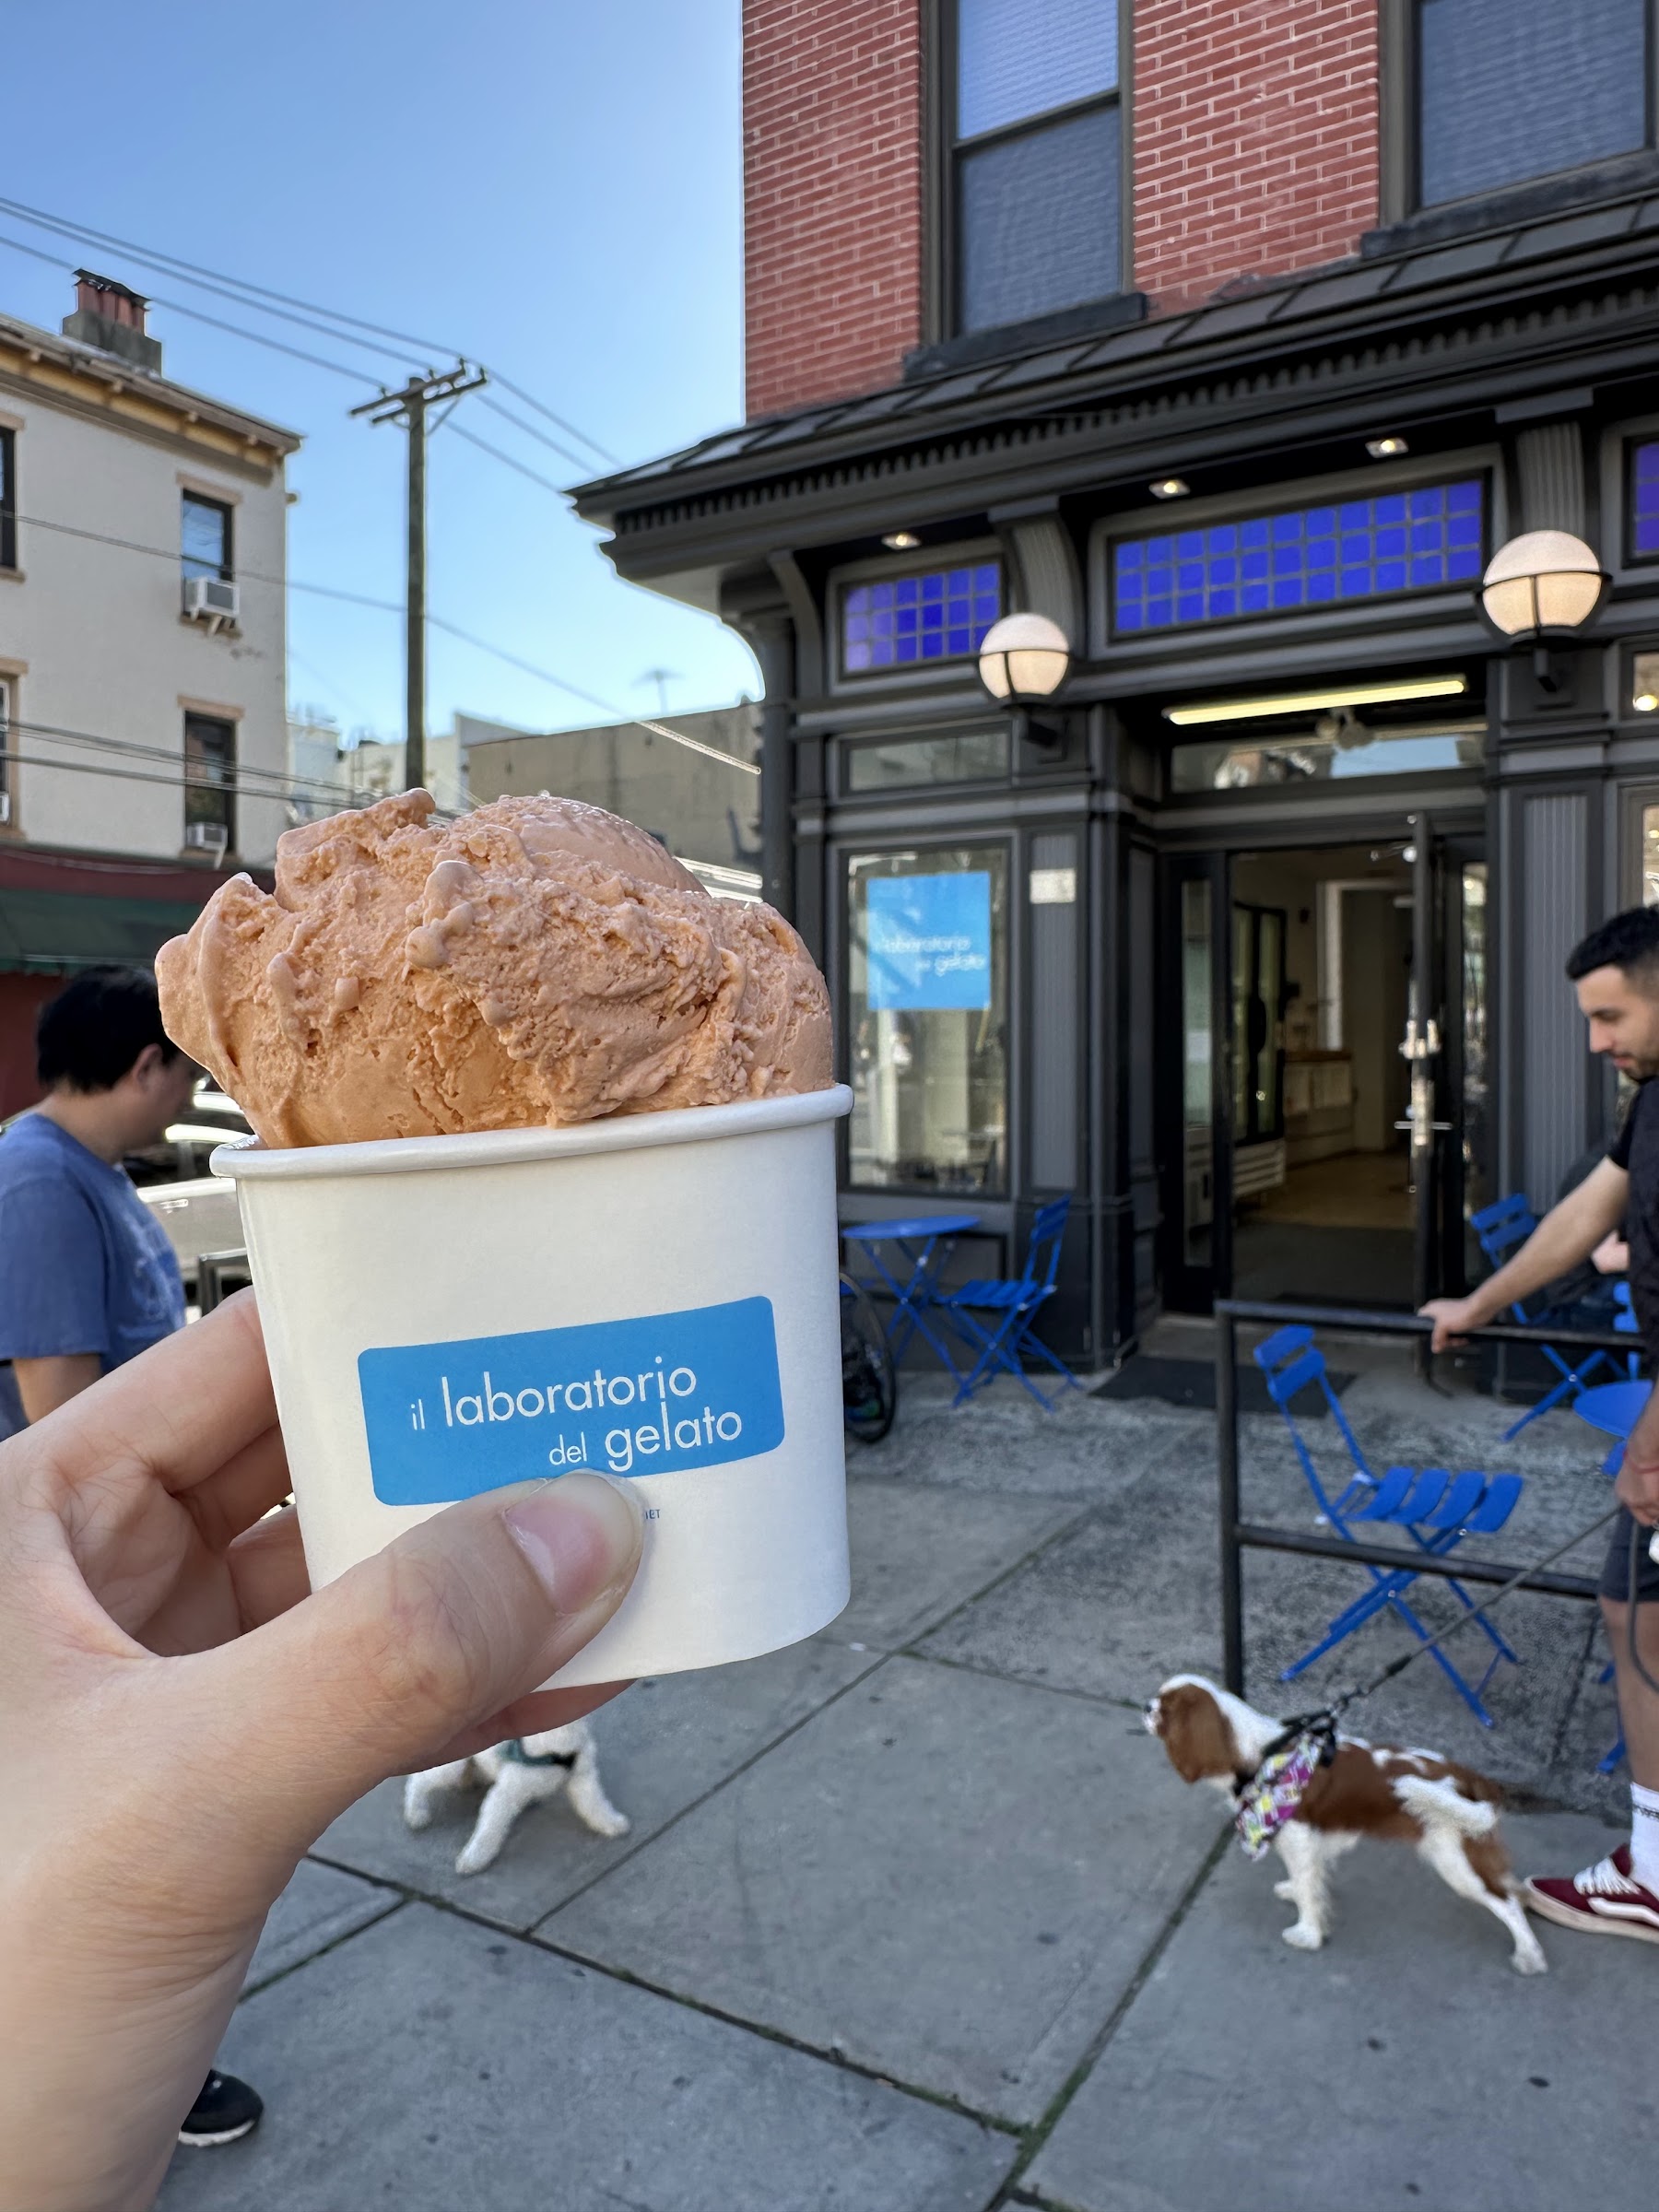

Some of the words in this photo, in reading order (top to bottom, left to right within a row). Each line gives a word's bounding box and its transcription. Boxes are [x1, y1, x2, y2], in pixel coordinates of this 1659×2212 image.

[410, 1398, 426, 1430] il
[441, 1356, 697, 1427] laboratorio
[548, 1431, 587, 1465] del
[605, 1401, 743, 1473] gelato
